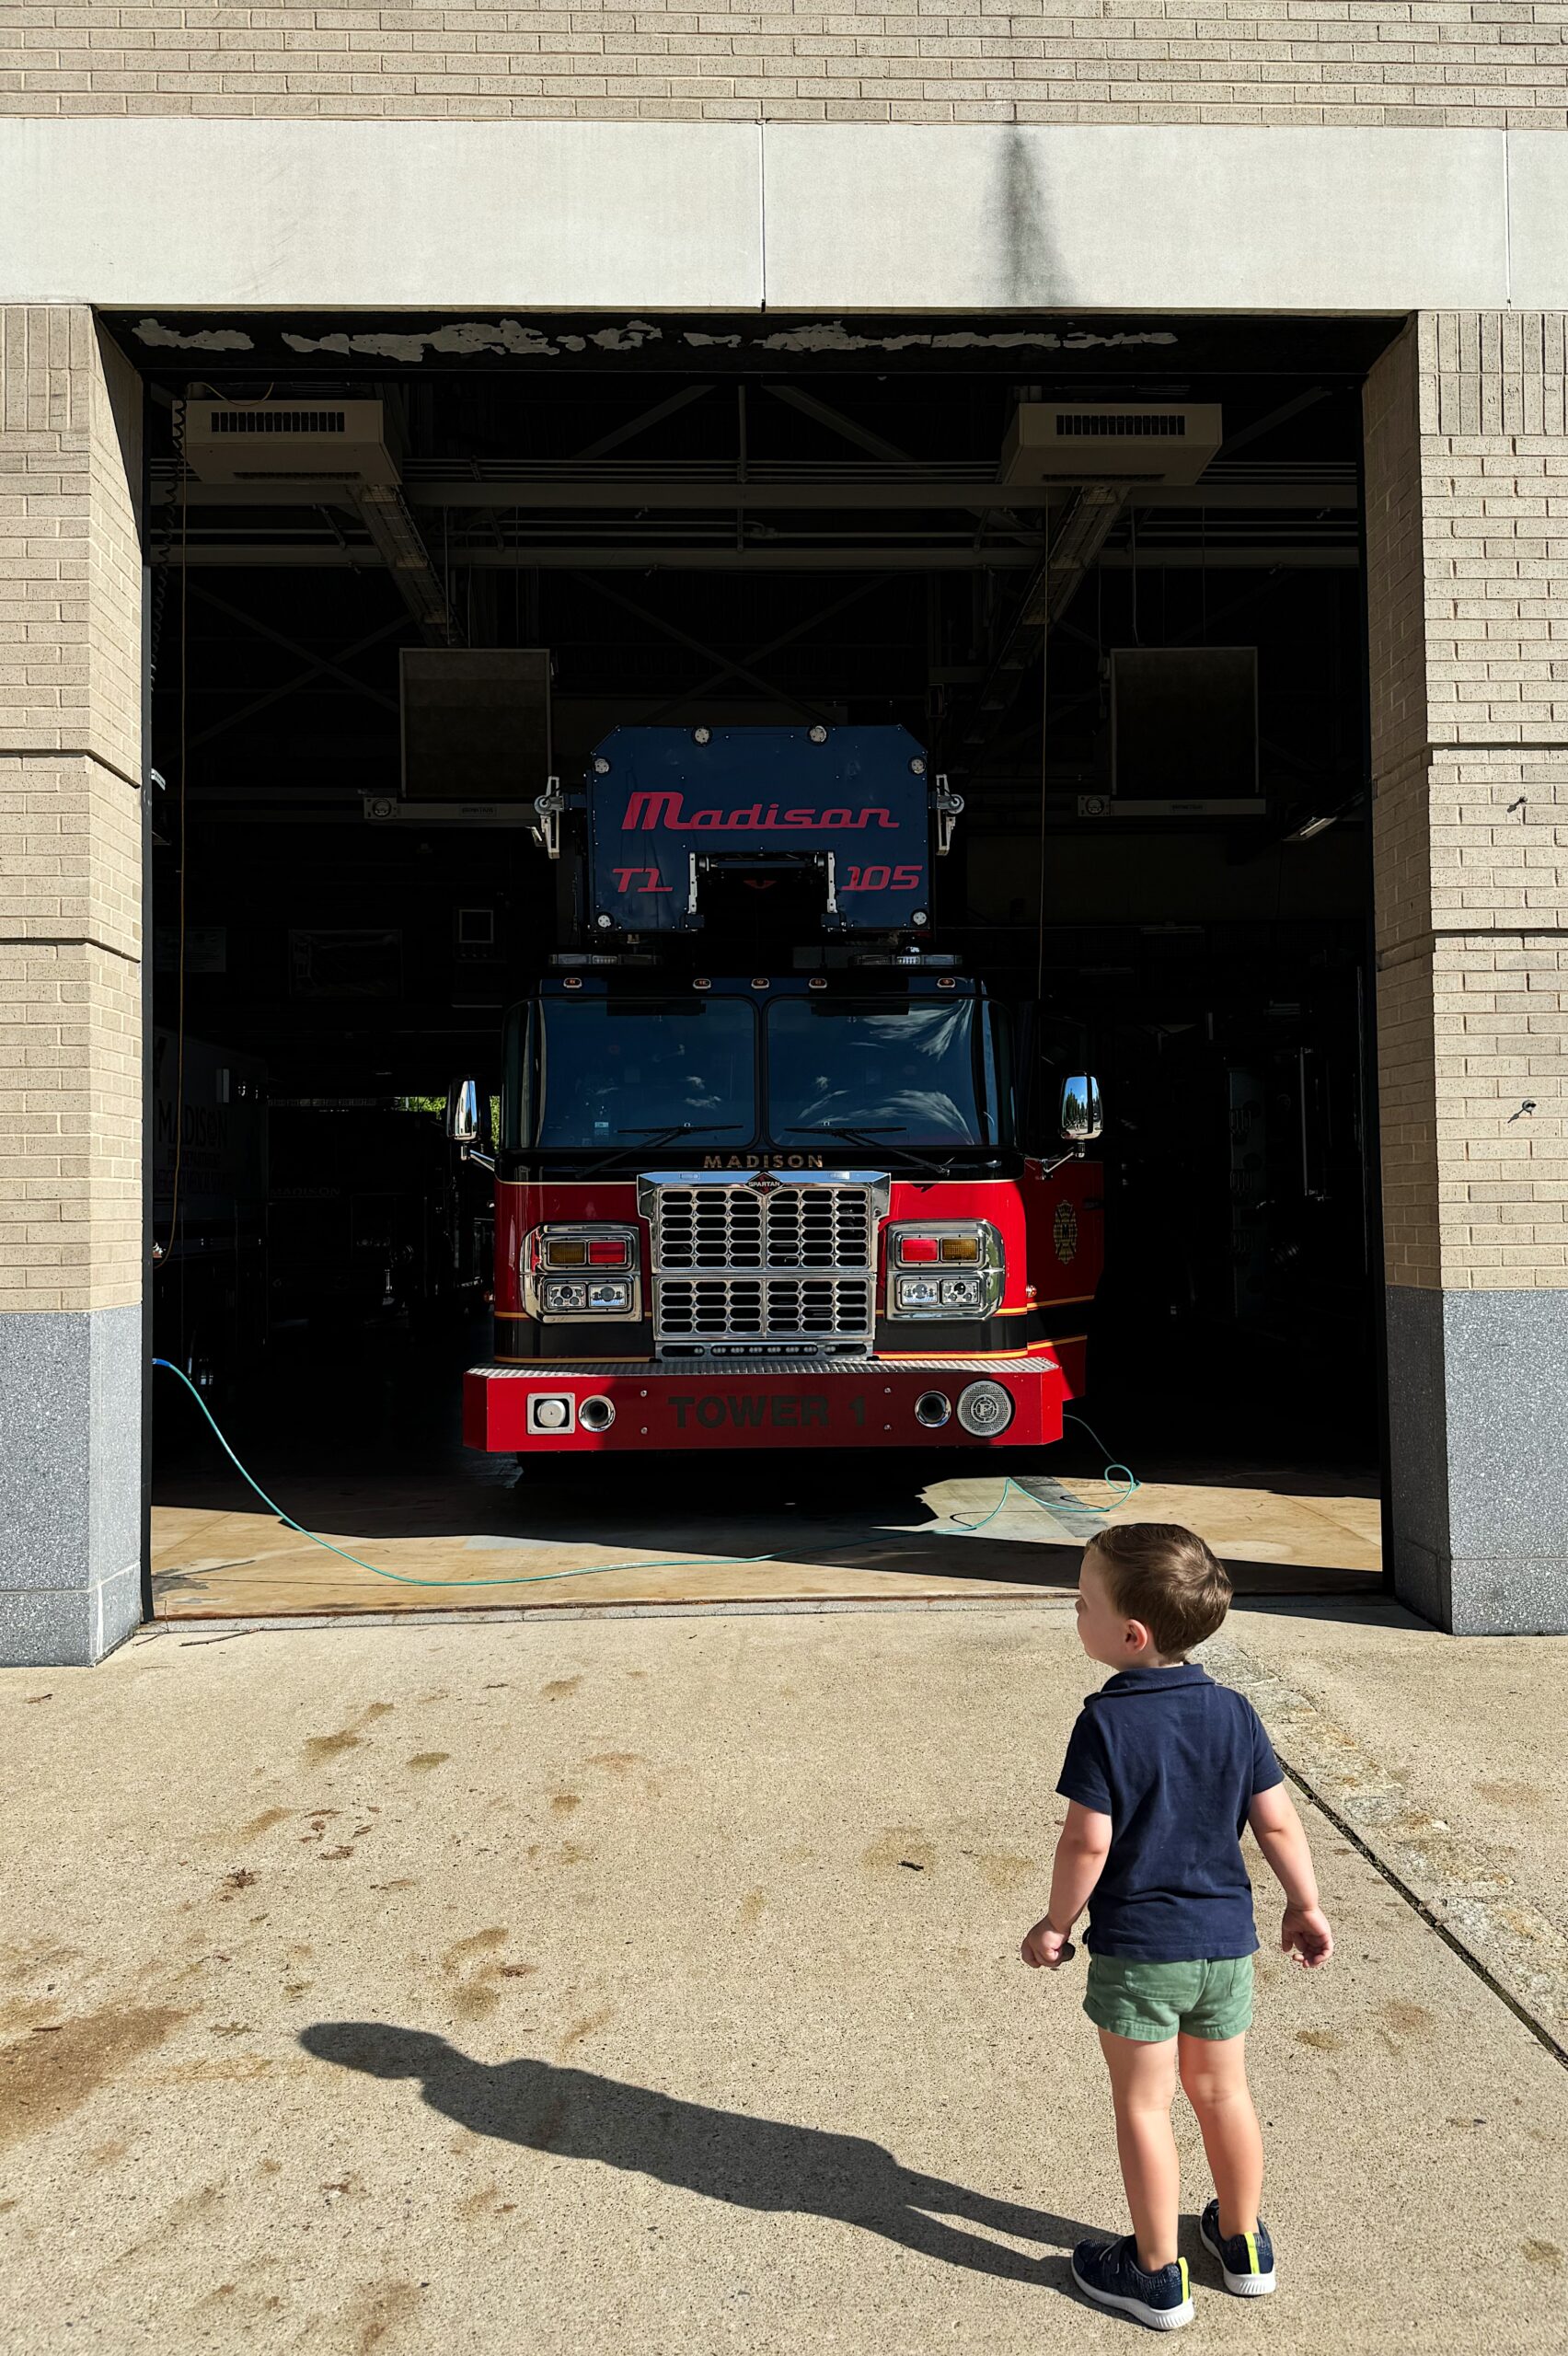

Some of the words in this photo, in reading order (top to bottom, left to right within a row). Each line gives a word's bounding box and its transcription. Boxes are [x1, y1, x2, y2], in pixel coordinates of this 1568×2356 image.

[622, 791, 900, 831] Madison
[612, 868, 674, 893] T1
[840, 865, 924, 892] 105
[703, 1154, 824, 1169] MADISON
[668, 1395, 829, 1428] TOWER
[848, 1395, 866, 1426] 1
